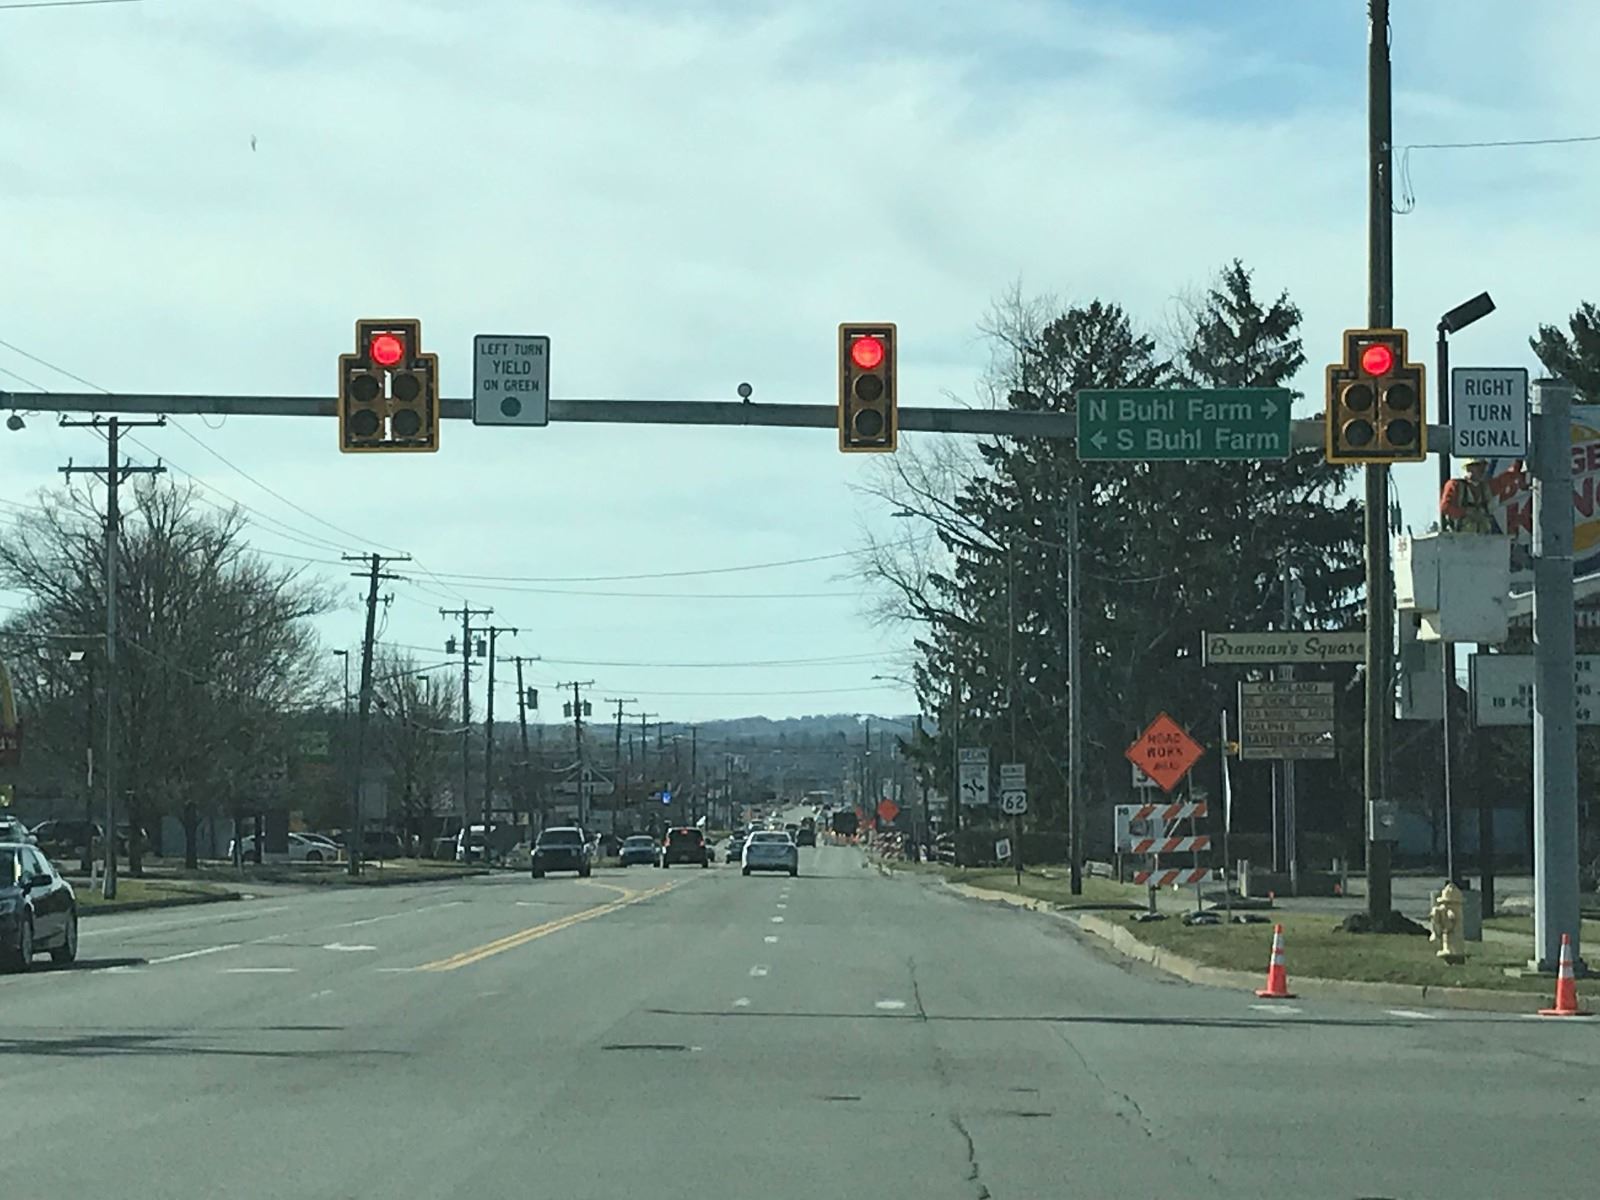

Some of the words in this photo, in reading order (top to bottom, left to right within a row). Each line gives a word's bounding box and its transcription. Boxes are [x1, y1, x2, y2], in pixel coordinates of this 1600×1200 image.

[481, 343, 508, 356] LEFT
[514, 343, 543, 356] TURN
[493, 359, 531, 375] YIELD
[483, 380, 498, 391] ON
[503, 380, 540, 392] GREEN
[1465, 378, 1514, 396] RIGHT
[1089, 399, 1107, 422] N
[1118, 399, 1175, 421] Buhl
[1187, 398, 1253, 421] Farm
[1468, 404, 1512, 421] TURN
[1117, 428, 1134, 451] S
[1146, 428, 1201, 450] Buhl
[1215, 427, 1279, 450] Farm
[1460, 430, 1520, 447] SIGNAL
[1210, 637, 1298, 657] Brannan's
[1147, 747, 1183, 759] WORK
[1006, 795, 1025, 810] 62
